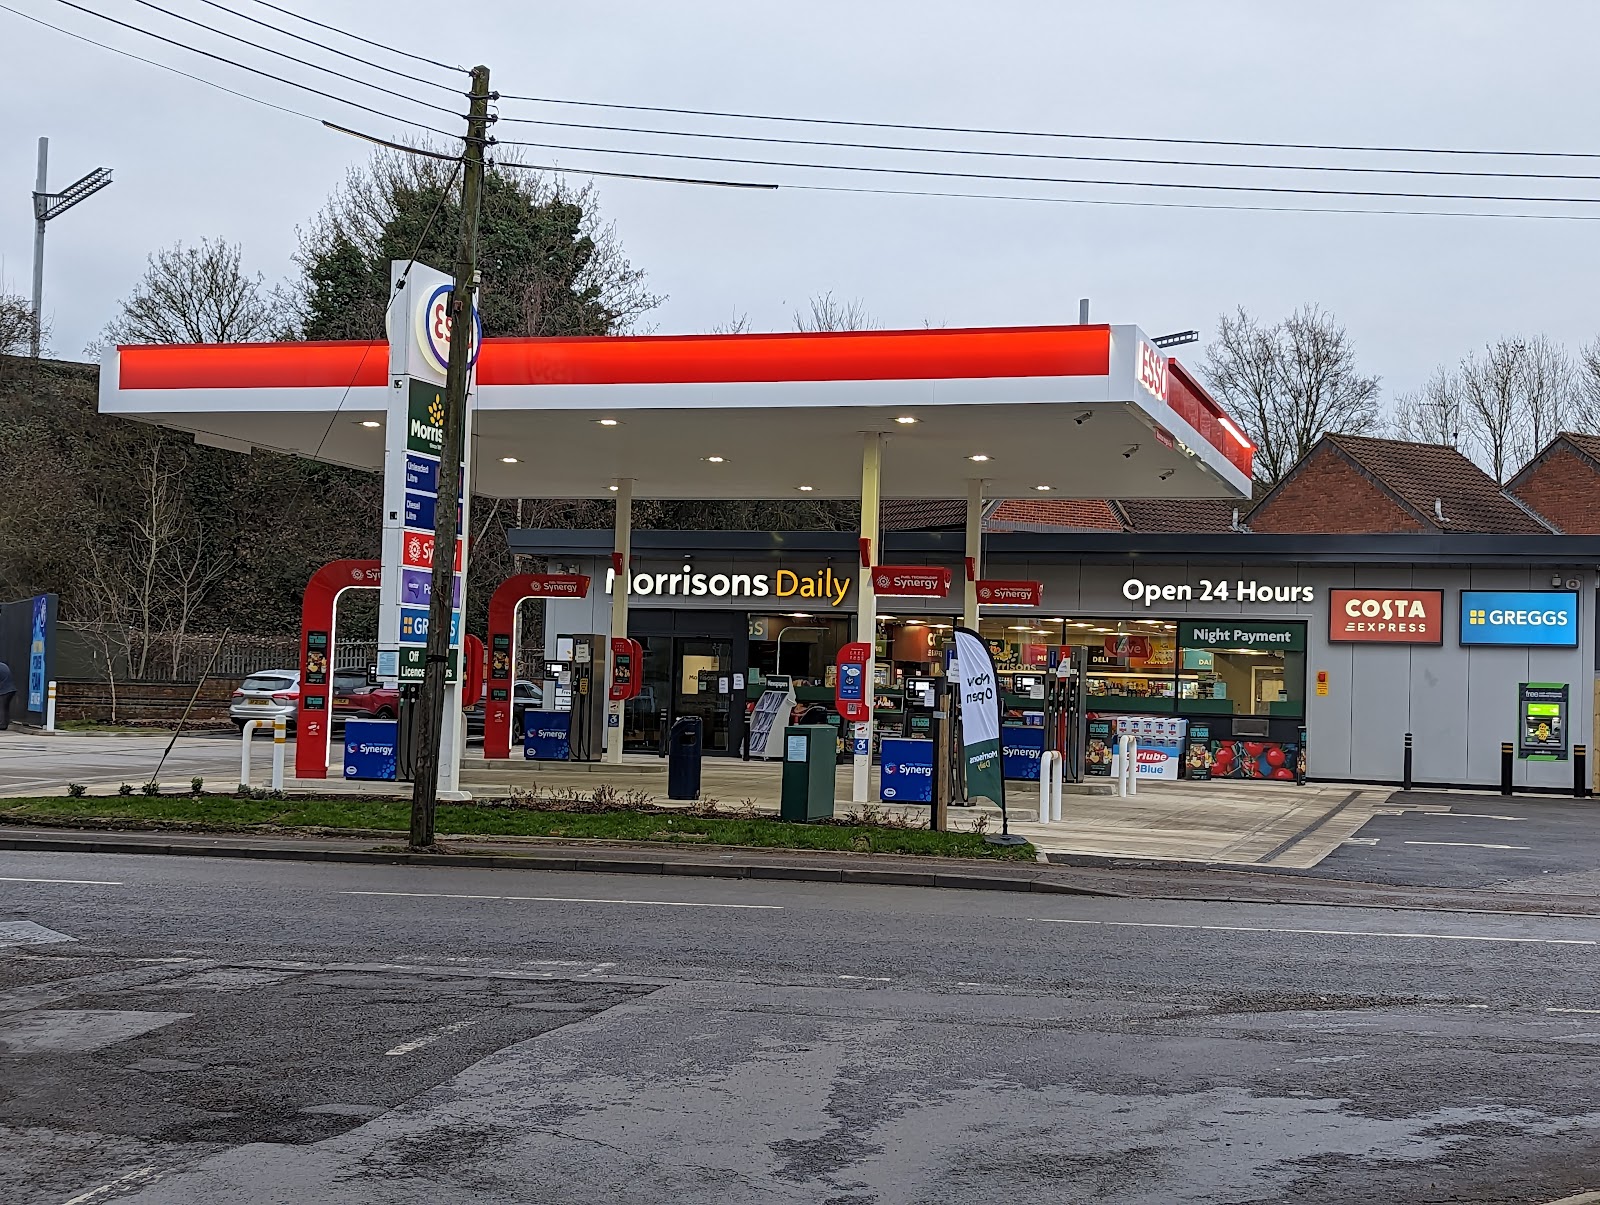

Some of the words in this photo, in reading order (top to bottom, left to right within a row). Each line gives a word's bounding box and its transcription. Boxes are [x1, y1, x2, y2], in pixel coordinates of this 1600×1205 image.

[407, 462, 429, 473] Unleaded
[407, 473, 418, 483] Litre
[406, 500, 420, 510] Diesel
[405, 511, 416, 520] Litre
[543, 582, 577, 592] Synergy
[776, 568, 850, 606] Daily
[894, 576, 938, 589] Synergy
[994, 588, 1032, 599] Synergy
[1122, 579, 1192, 606] Open
[1199, 580, 1228, 601] 24
[1237, 580, 1314, 602] Hours
[1345, 599, 1426, 620] COSTA
[1489, 610, 1568, 626] GREGGS
[1358, 623, 1426, 633] EXPRESS
[1193, 628, 1230, 644] Night
[1233, 629, 1291, 644] Payment
[409, 650, 420, 662] Off
[401, 666, 425, 678] Licence
[538, 730, 567, 739] Synergy
[360, 744, 393, 755] Synergy
[1002, 746, 1040, 758] Synergy
[900, 764, 933, 777] Synerg
